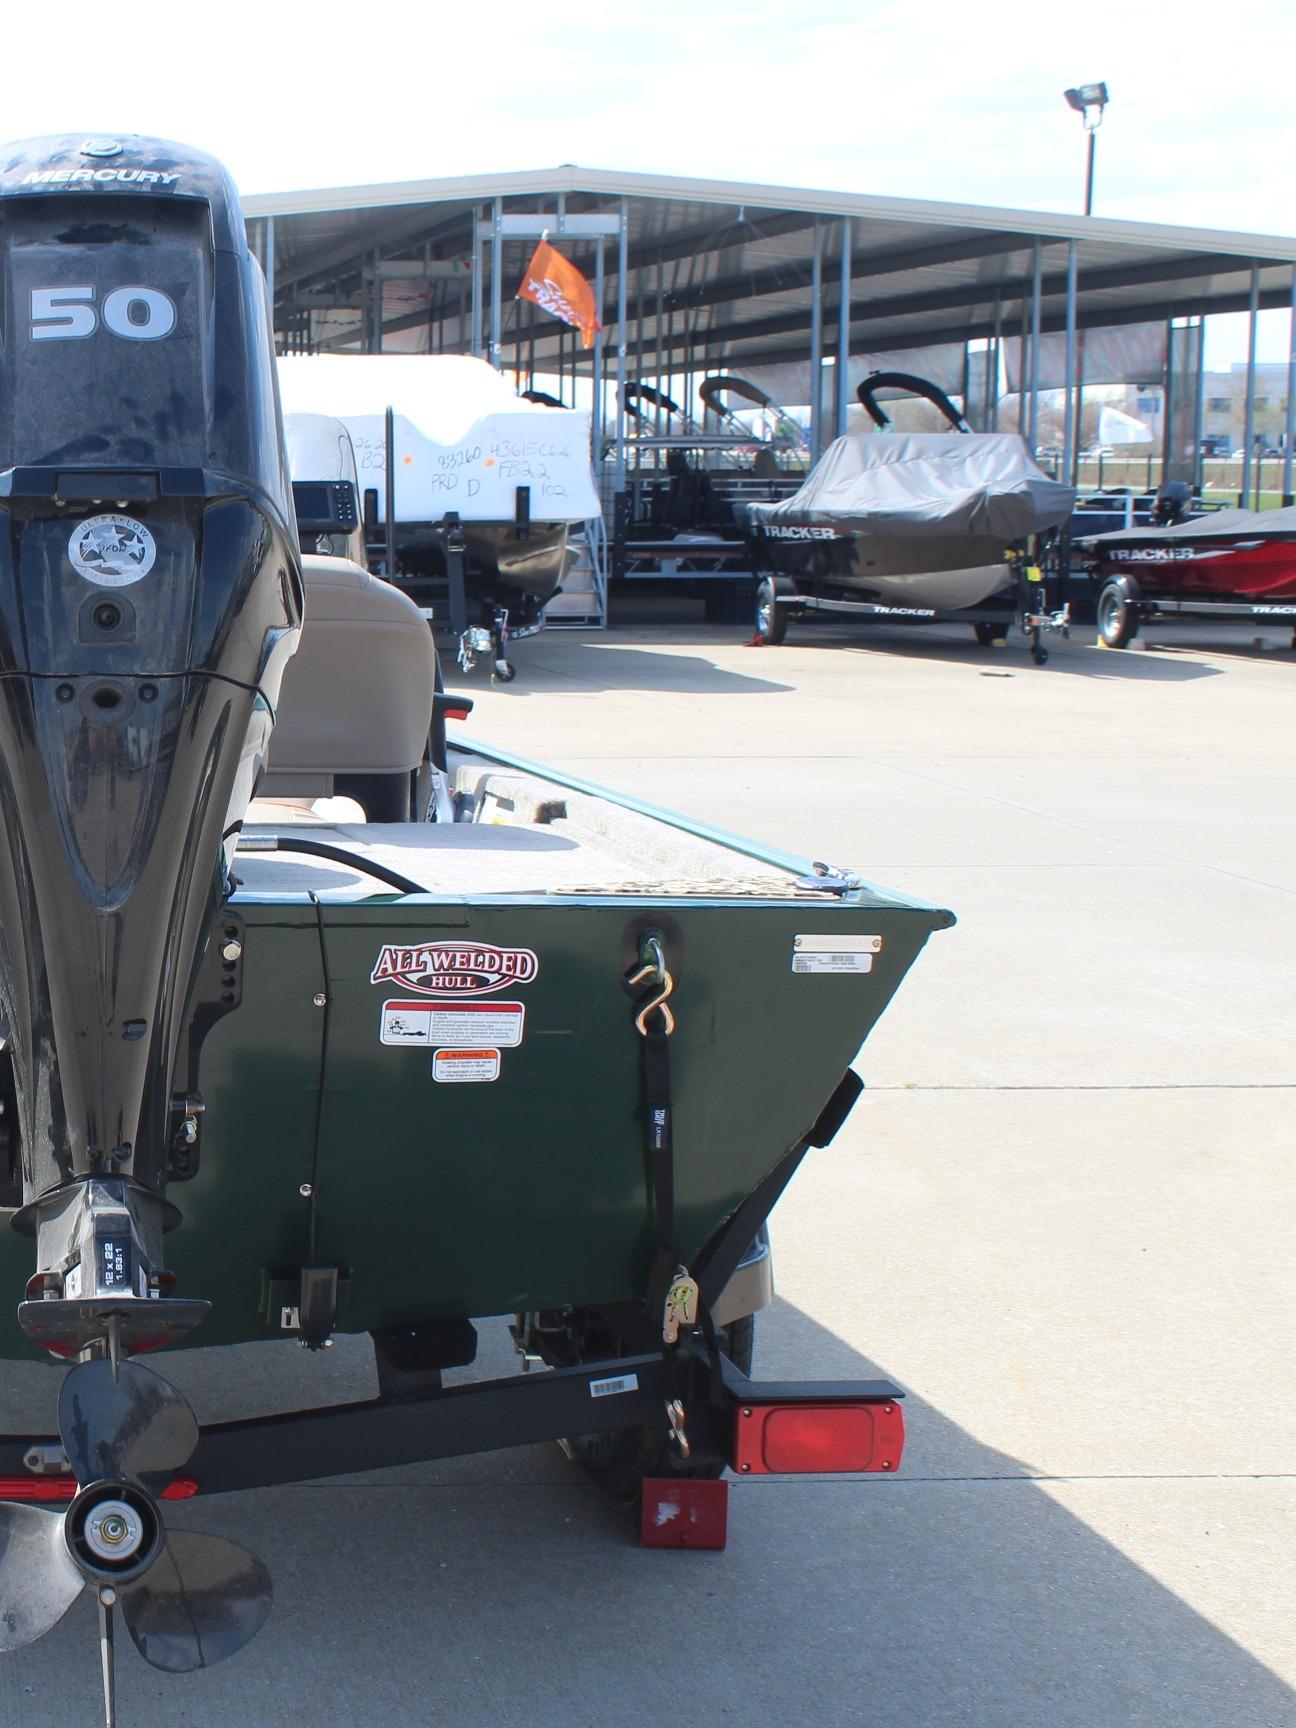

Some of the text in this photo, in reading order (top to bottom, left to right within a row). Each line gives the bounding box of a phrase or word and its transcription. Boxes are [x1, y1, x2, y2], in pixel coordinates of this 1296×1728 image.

[23, 168, 182, 184] MERCURY
[30, 285, 176, 341] 50
[126, 518, 150, 538] LOW
[764, 525, 838, 540] TRACKER
[1107, 547, 1195, 561] TRACKER
[871, 605, 936, 616] TRACKER
[375, 949, 533, 979] ALL WELDED
[430, 975, 477, 988] HULL
[104, 1242, 114, 1260] 22
[105, 1274, 114, 1286] 12
